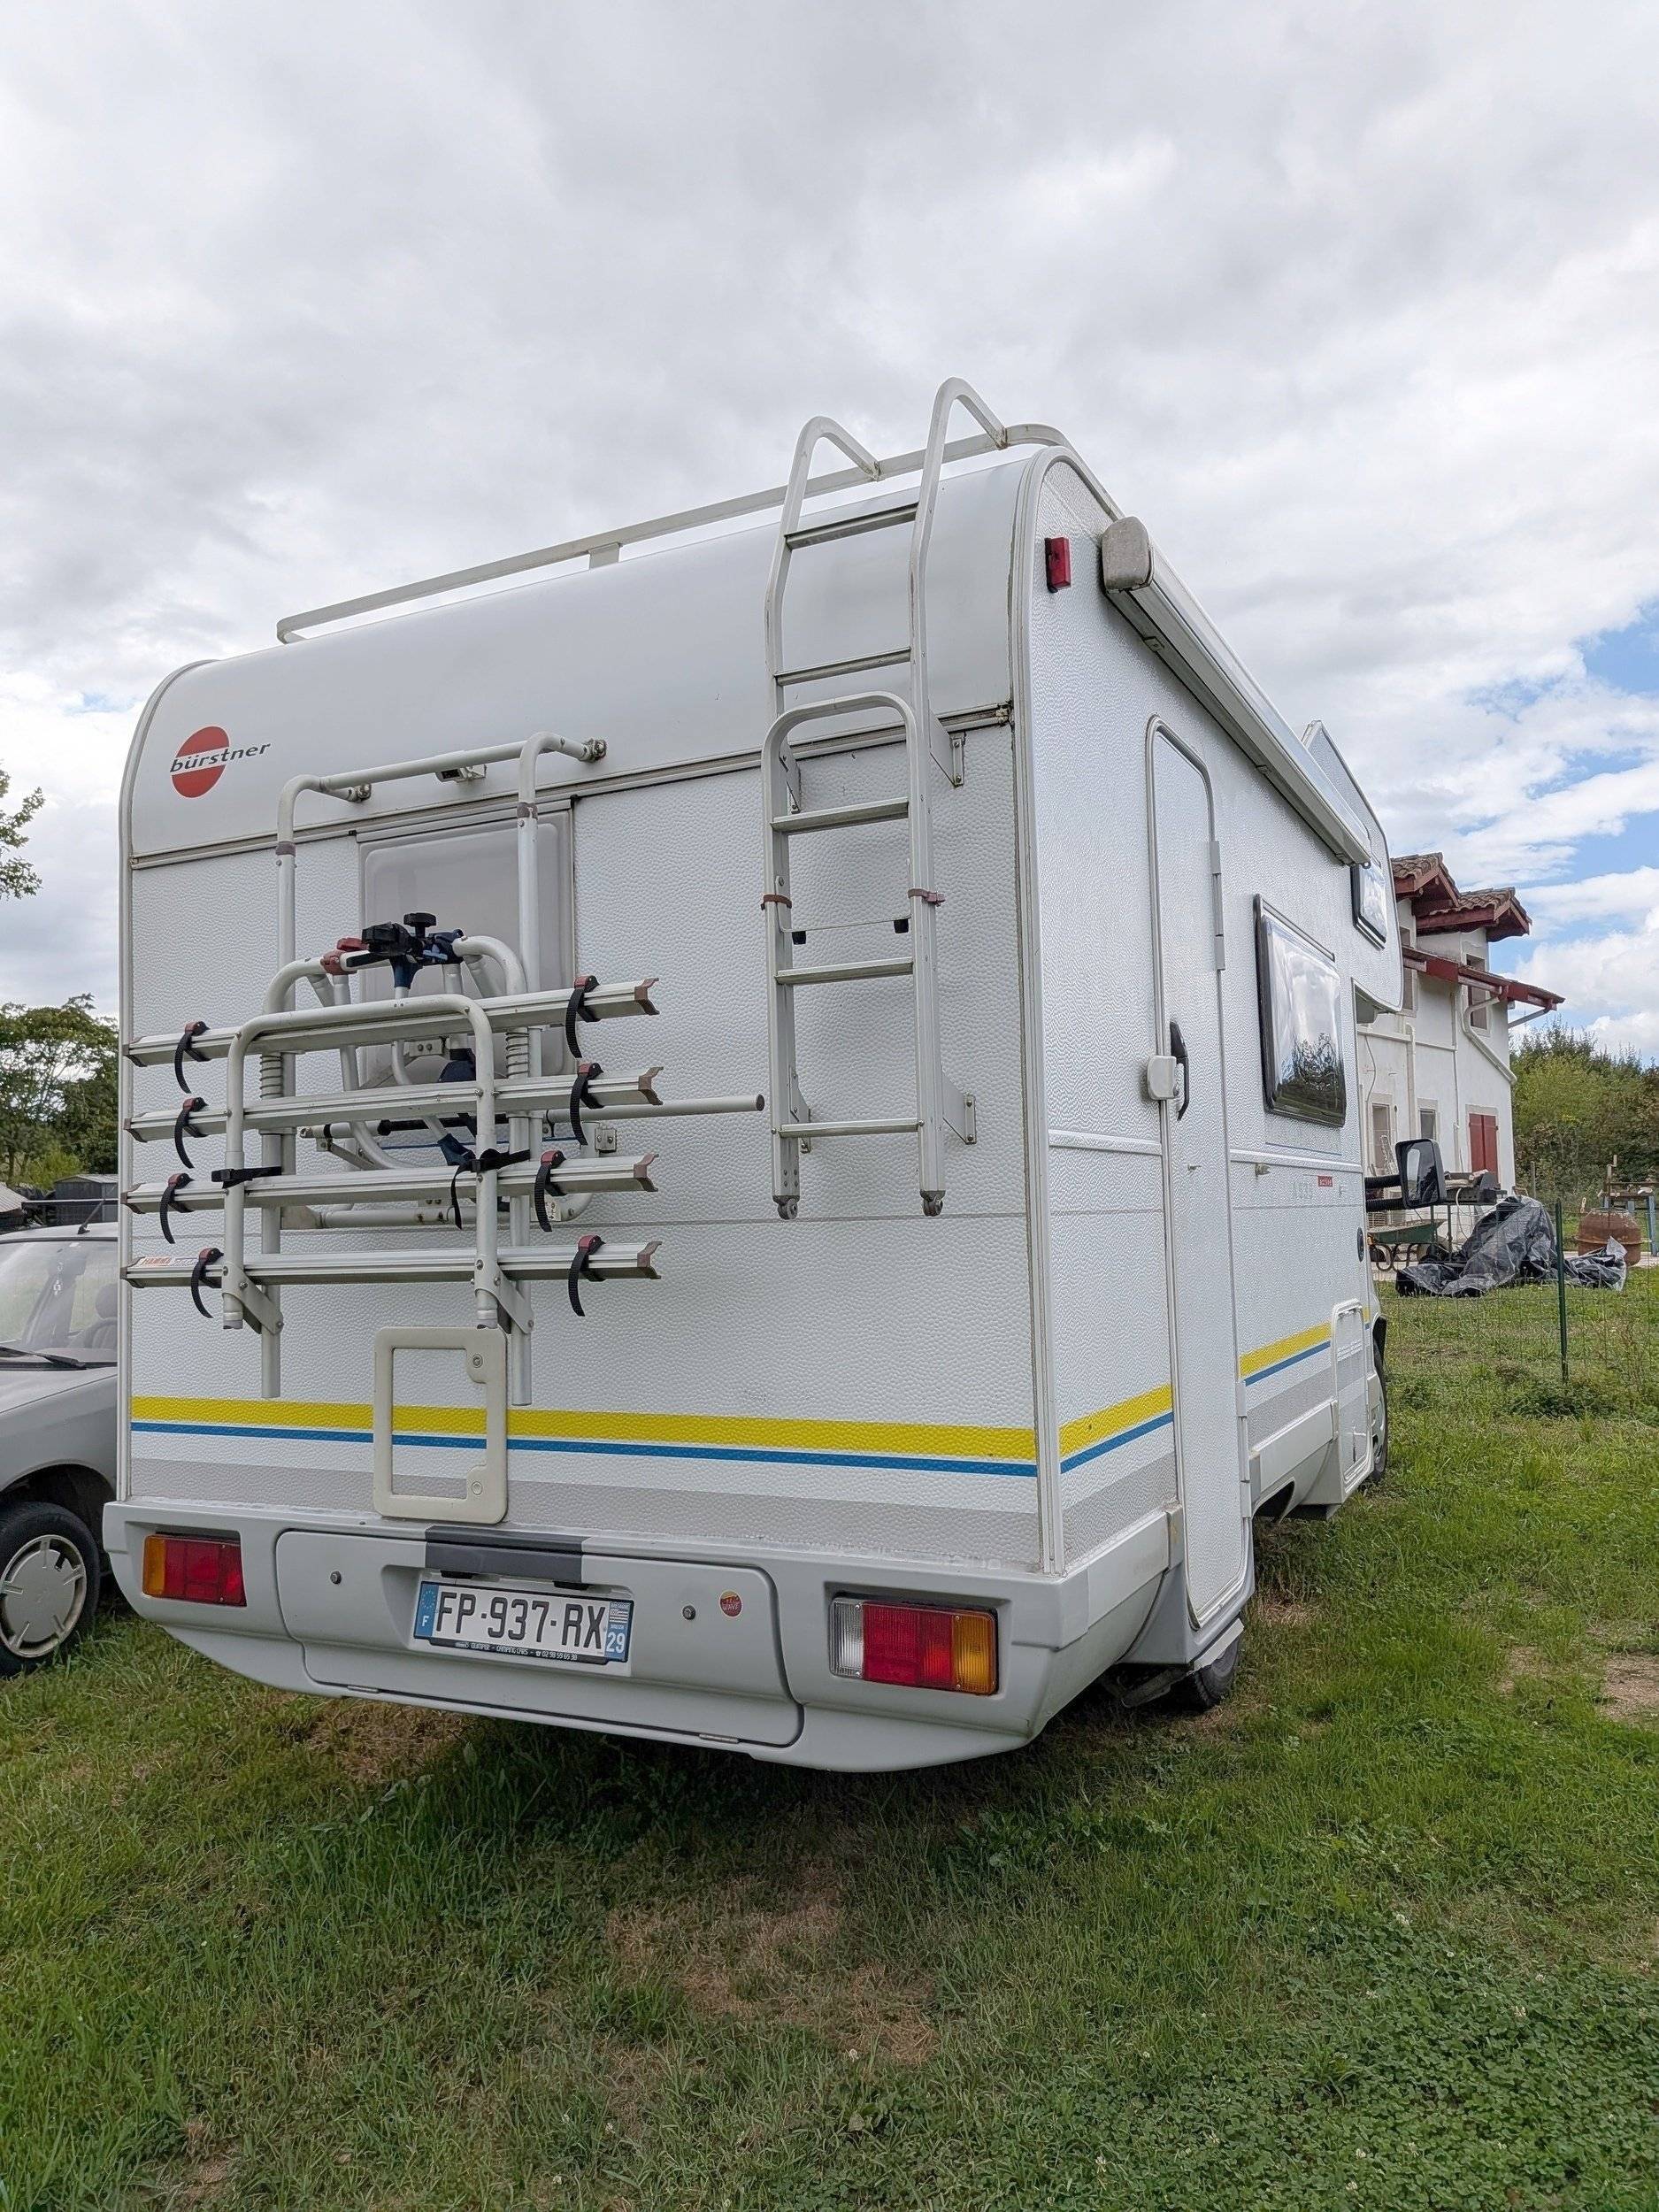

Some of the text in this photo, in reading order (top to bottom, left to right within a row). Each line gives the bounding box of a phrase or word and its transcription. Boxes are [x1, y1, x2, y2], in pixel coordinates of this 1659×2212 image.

[170, 743, 271, 772] bürstner
[421, 1615, 430, 1627] F
[436, 1591, 606, 1649] FP-937-RX
[606, 1632, 626, 1654] 29
